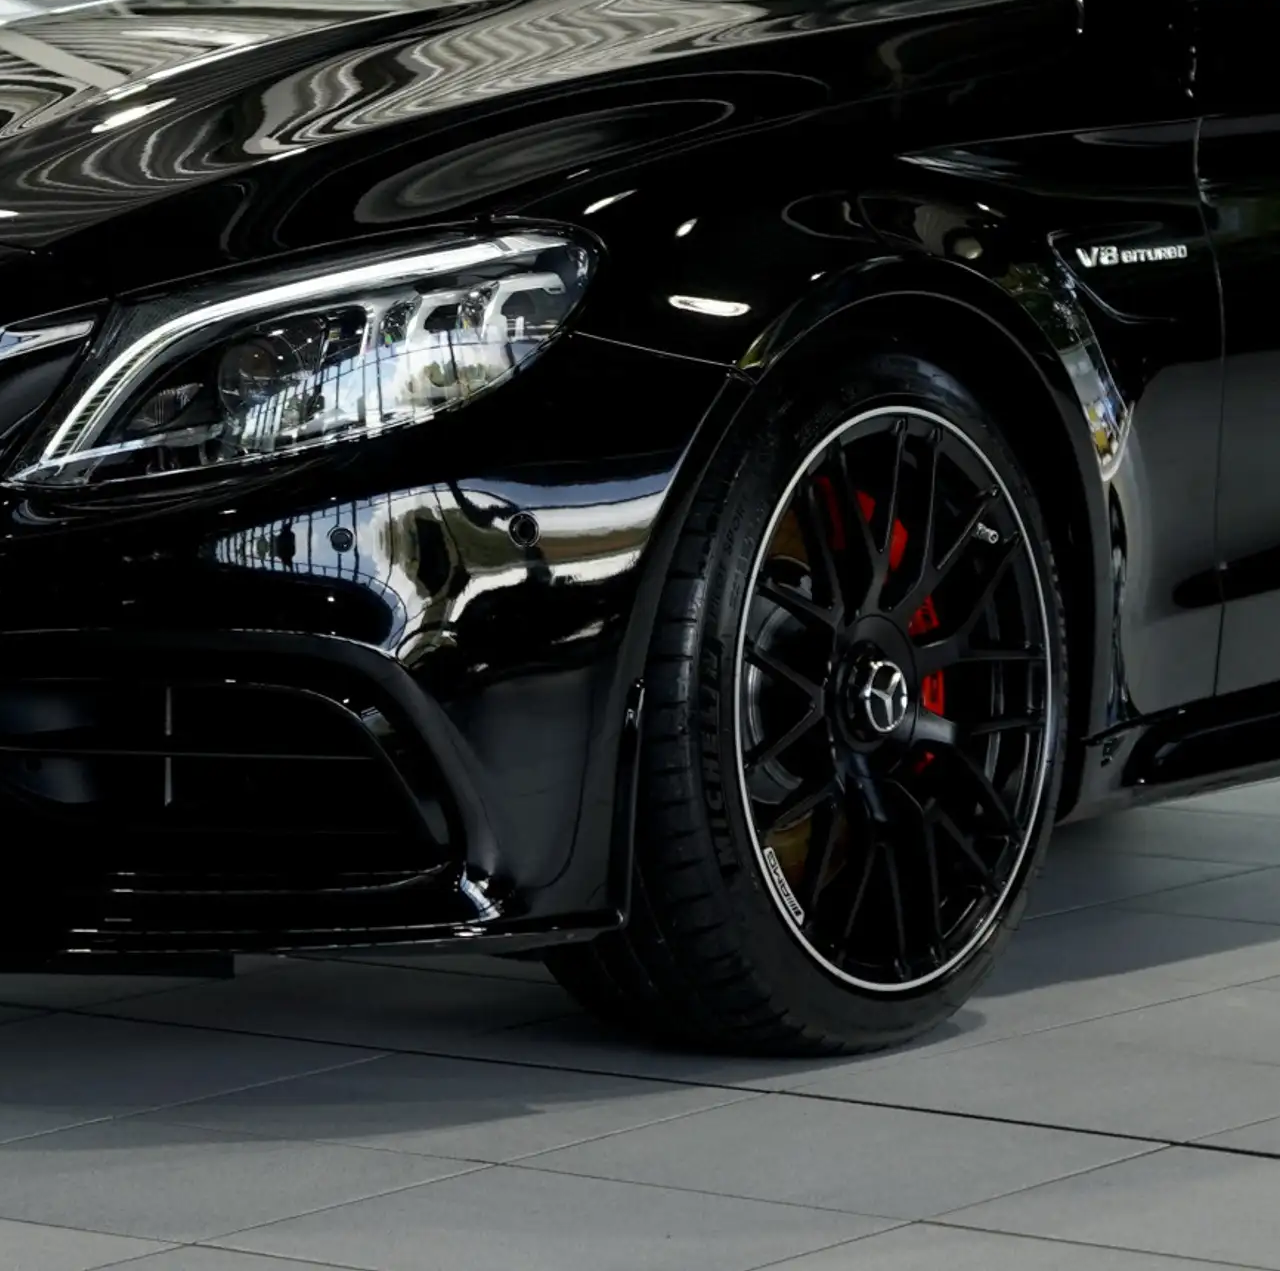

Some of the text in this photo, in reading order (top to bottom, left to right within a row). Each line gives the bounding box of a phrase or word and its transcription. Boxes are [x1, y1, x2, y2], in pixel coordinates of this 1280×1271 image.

[1076, 245, 1188, 268] V8 BITURBO
[699, 648, 737, 866] MICHELIN
